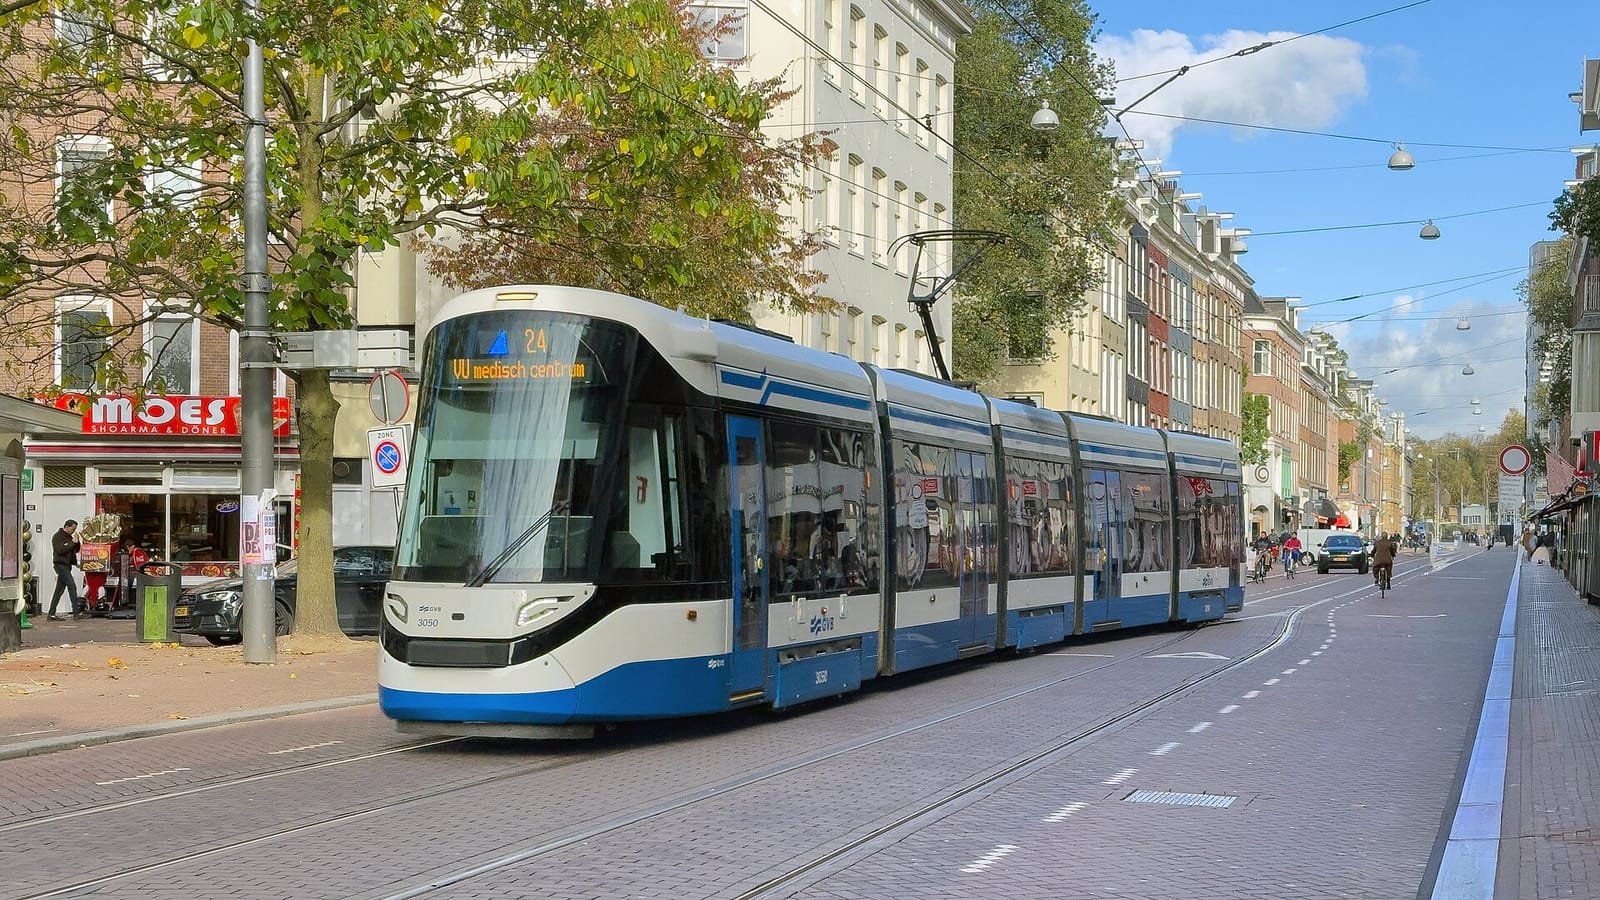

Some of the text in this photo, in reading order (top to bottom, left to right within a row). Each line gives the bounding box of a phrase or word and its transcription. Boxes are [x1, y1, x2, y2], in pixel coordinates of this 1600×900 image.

[524, 328, 548, 354] 24
[453, 358, 586, 380] VU medisch centrum
[92, 397, 226, 425] MOES
[91, 424, 226, 435] SHOARMA & DÖNER
[377, 431, 395, 439] ZONE
[417, 618, 439, 628] 3050
[821, 617, 835, 632] GVB
